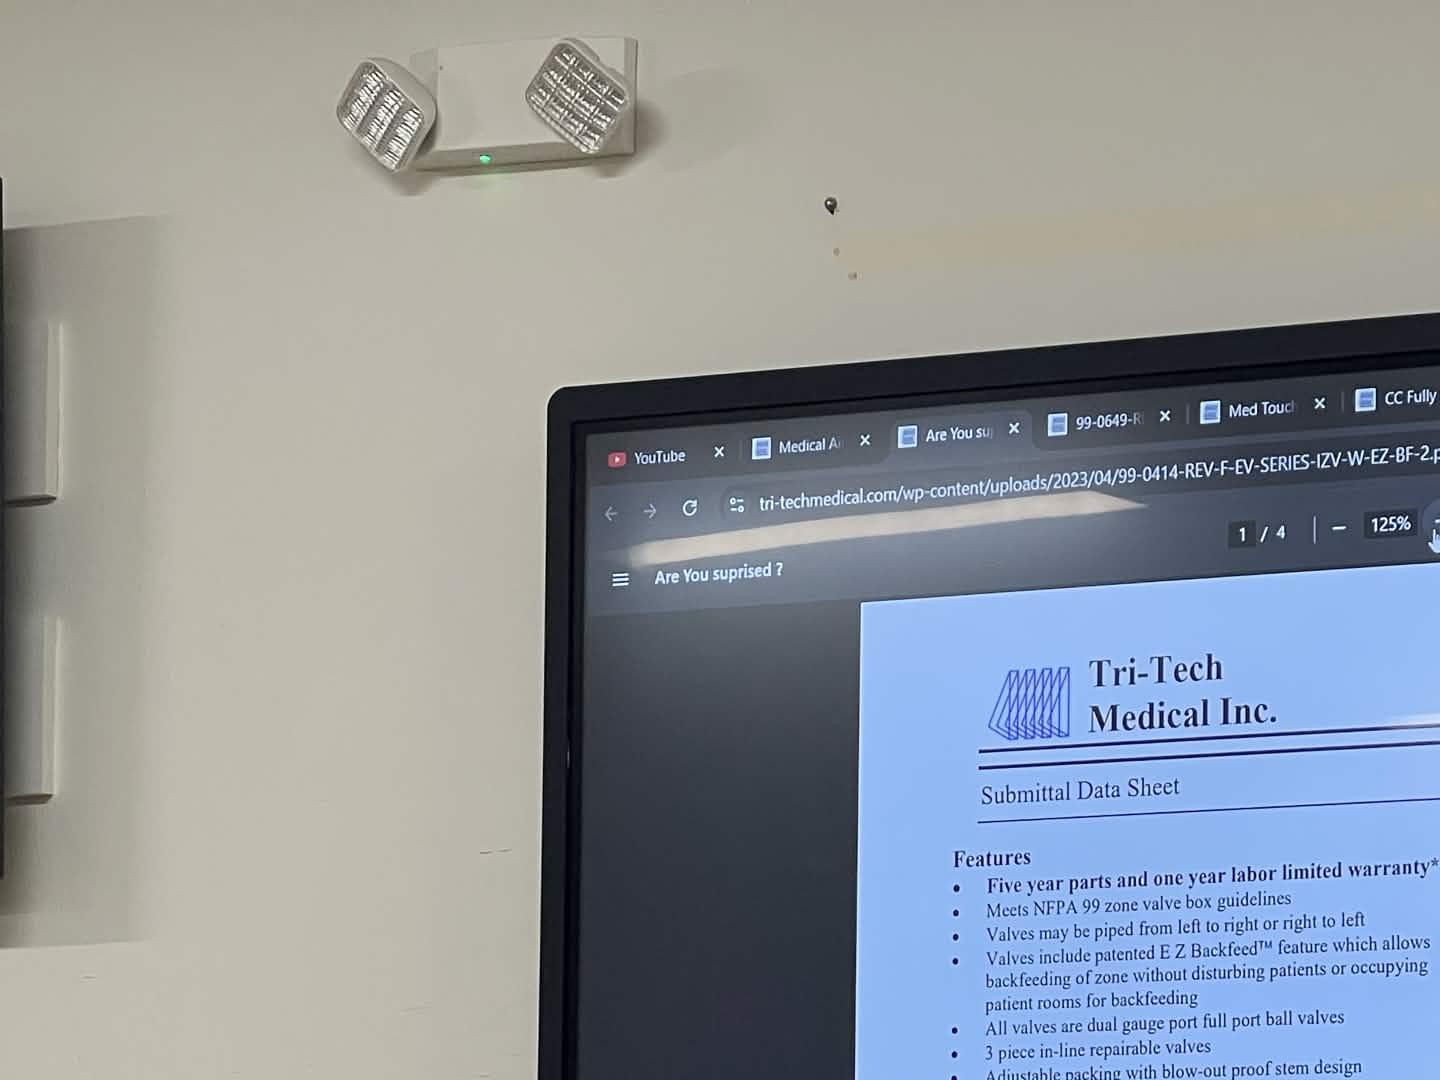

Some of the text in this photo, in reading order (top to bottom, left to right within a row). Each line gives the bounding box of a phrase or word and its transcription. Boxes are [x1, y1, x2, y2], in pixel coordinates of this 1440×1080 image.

[1384, 390, 1403, 405] CC
[1406, 389, 1437, 408] Fully
[1228, 403, 1257, 418] Med
[1076, 411, 1144, 430] 99-0649-R
[924, 428, 947, 443] Are
[949, 426, 973, 441] You
[633, 449, 686, 465] YouTube
[778, 440, 825, 455] Medical
[1238, 527, 1245, 541] 1
[1275, 526, 1285, 540] 4
[1371, 516, 1411, 533] 125%
[654, 565, 783, 585] Are You suprised ?
[1088, 654, 1222, 687] Tri-Tech
[1087, 698, 1276, 732] Medical Inc.
[980, 776, 1180, 804] Submittal Data Sheet
[953, 850, 1031, 869] Features
[987, 877, 1022, 894] Five
[1026, 880, 1064, 896] year
[1068, 874, 1111, 894] parts
[1116, 872, 1148, 888] and
[1153, 875, 1183, 887] one
[1188, 873, 1226, 889] year
[1231, 867, 1277, 883] labor
[1282, 864, 1342, 881] limited
[986, 891, 1291, 918] Meets NFPA 99 zone valve box guidelines
[984, 1039, 1211, 1064] 3 piece in-line repairable valves
